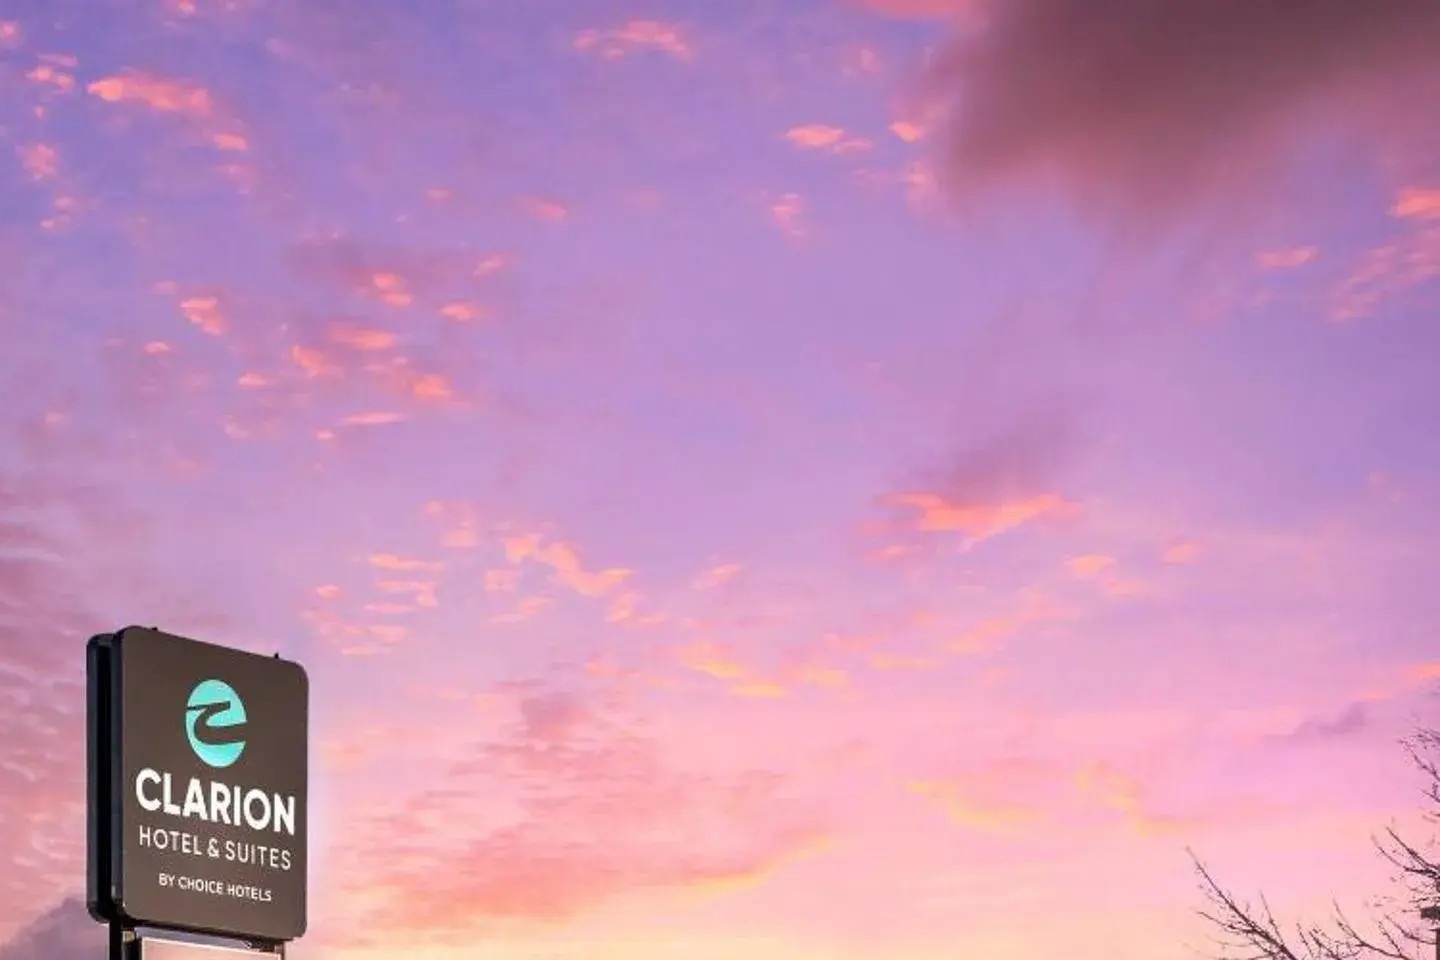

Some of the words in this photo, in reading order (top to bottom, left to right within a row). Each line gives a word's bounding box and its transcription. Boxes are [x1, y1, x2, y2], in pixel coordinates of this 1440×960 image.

[135, 768, 295, 836] CLARION
[139, 825, 202, 856] HOTEL
[207, 838, 220, 858] &
[225, 841, 292, 871] SUITES
[159, 873, 175, 888] BY
[178, 876, 224, 896] CHOICE
[227, 883, 272, 902] HOTELS
